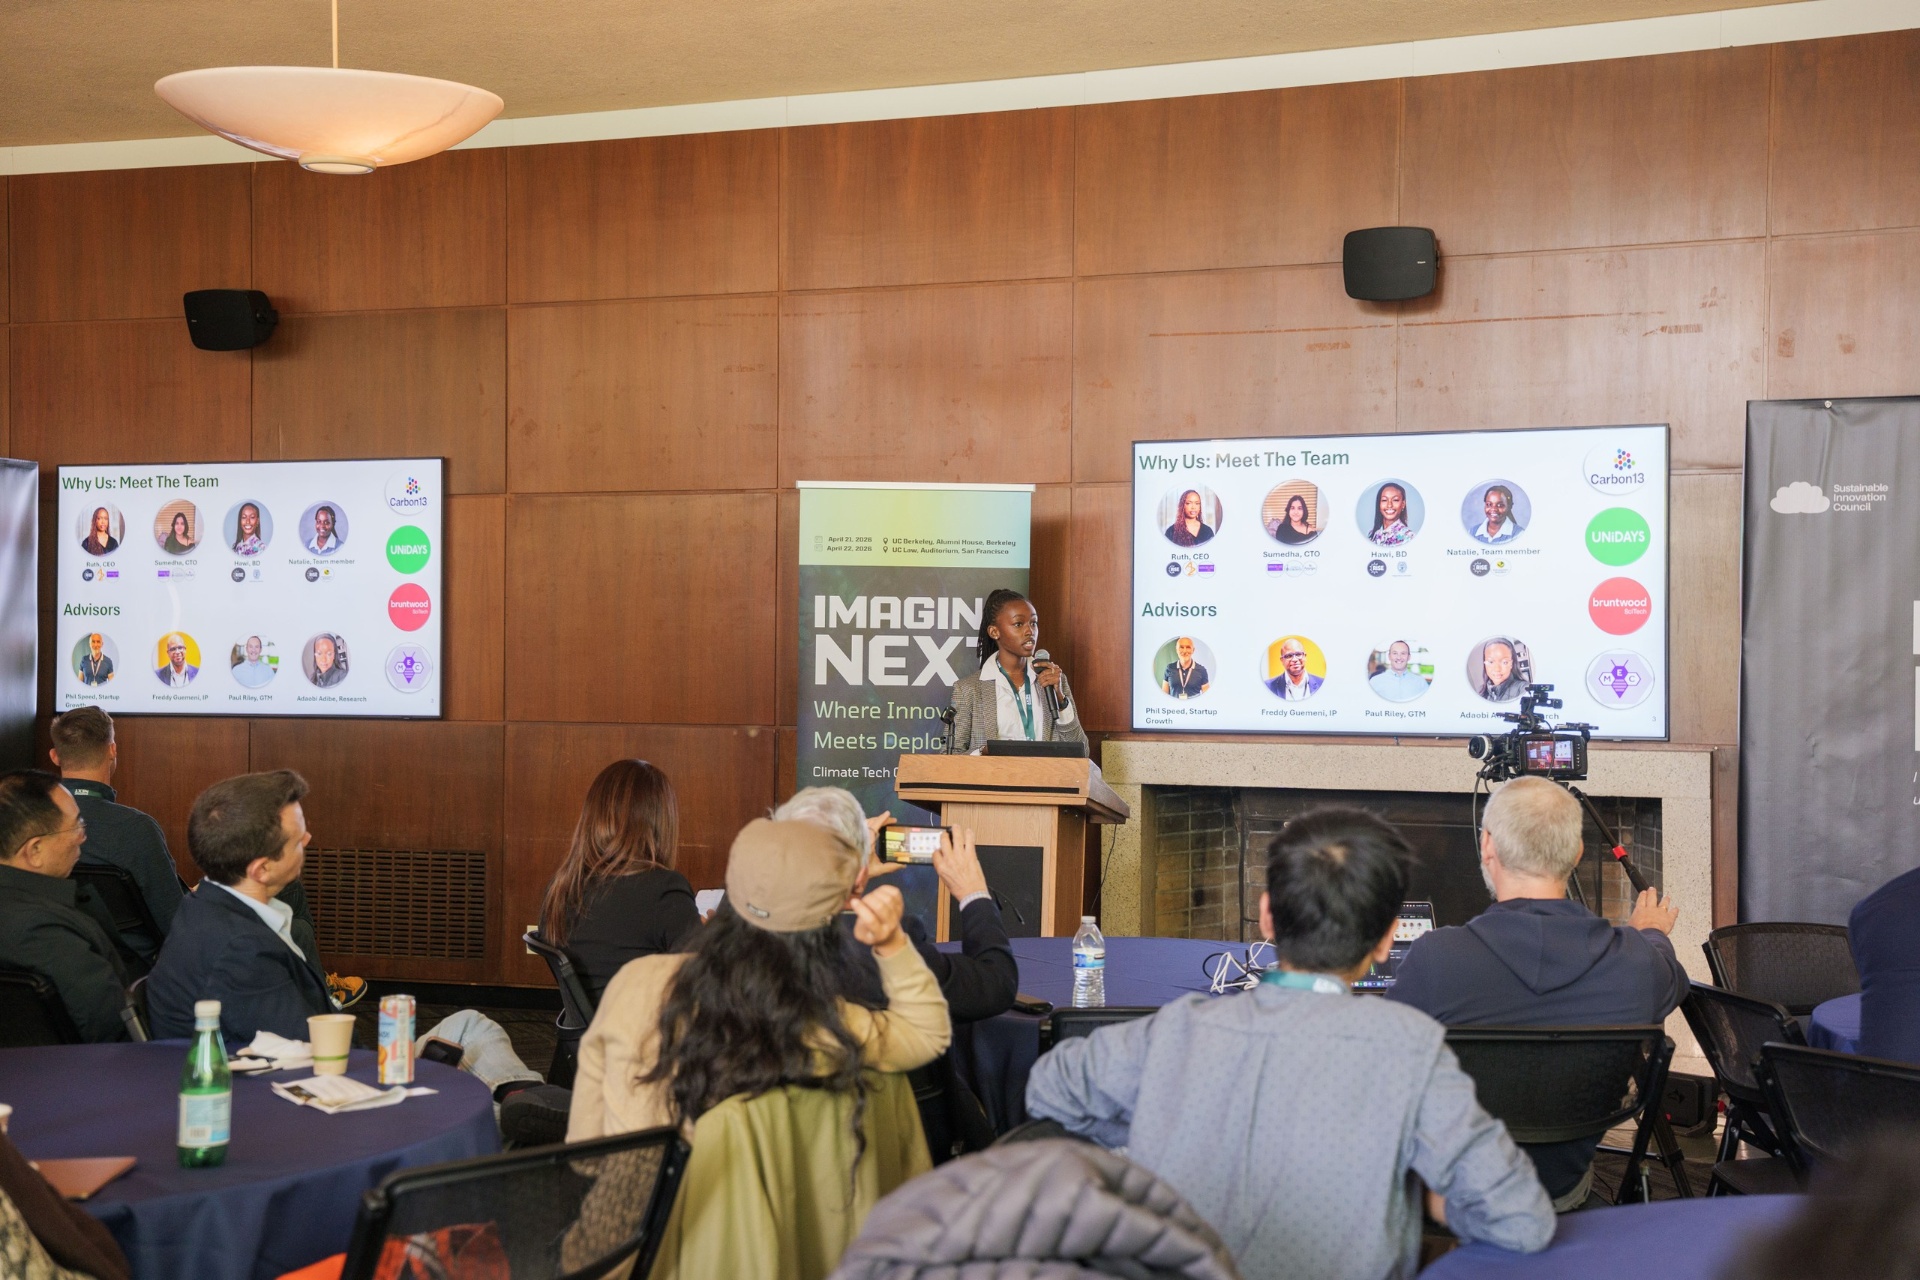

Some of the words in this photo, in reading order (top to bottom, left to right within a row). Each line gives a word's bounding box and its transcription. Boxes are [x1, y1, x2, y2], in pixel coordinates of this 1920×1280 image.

[1139, 454, 1178, 473] Why
[1182, 454, 1211, 469] Us:
[1215, 453, 1260, 468] Meet
[1264, 452, 1297, 467] The
[1301, 450, 1350, 466] Team
[62, 476, 92, 492] Why
[95, 476, 117, 489] Us:
[119, 476, 153, 489] Meet
[156, 475, 180, 488] The
[183, 475, 219, 488] Team
[1590, 472, 1645, 485] Carbon13
[1833, 483, 1889, 493] Sustainable
[390, 496, 428, 507] Carbon13
[1833, 493, 1886, 502] Innovation
[1833, 502, 1872, 512] Council
[1592, 530, 1645, 543] UNiDAYS
[1171, 553, 1191, 561] Ruth,
[1263, 551, 1302, 559] Sumedha,
[1481, 548, 1504, 556] Team
[390, 600, 428, 608] bruntwood
[1593, 597, 1647, 607] bruntwood
[64, 602, 121, 617] Advisors
[1142, 602, 1218, 617] Advisors
[814, 700, 881, 719] Where
[1145, 707, 1160, 715] Phil
[1189, 708, 1218, 716] Startup
[1261, 709, 1288, 718] Freddy
[1408, 710, 1426, 718] GTM
[1460, 711, 1489, 719] Adaobi
[1145, 717, 1173, 725] Growth
[814, 731, 878, 750] Meets
[812, 766, 860, 778] Climate
[862, 767, 891, 778] Tech
